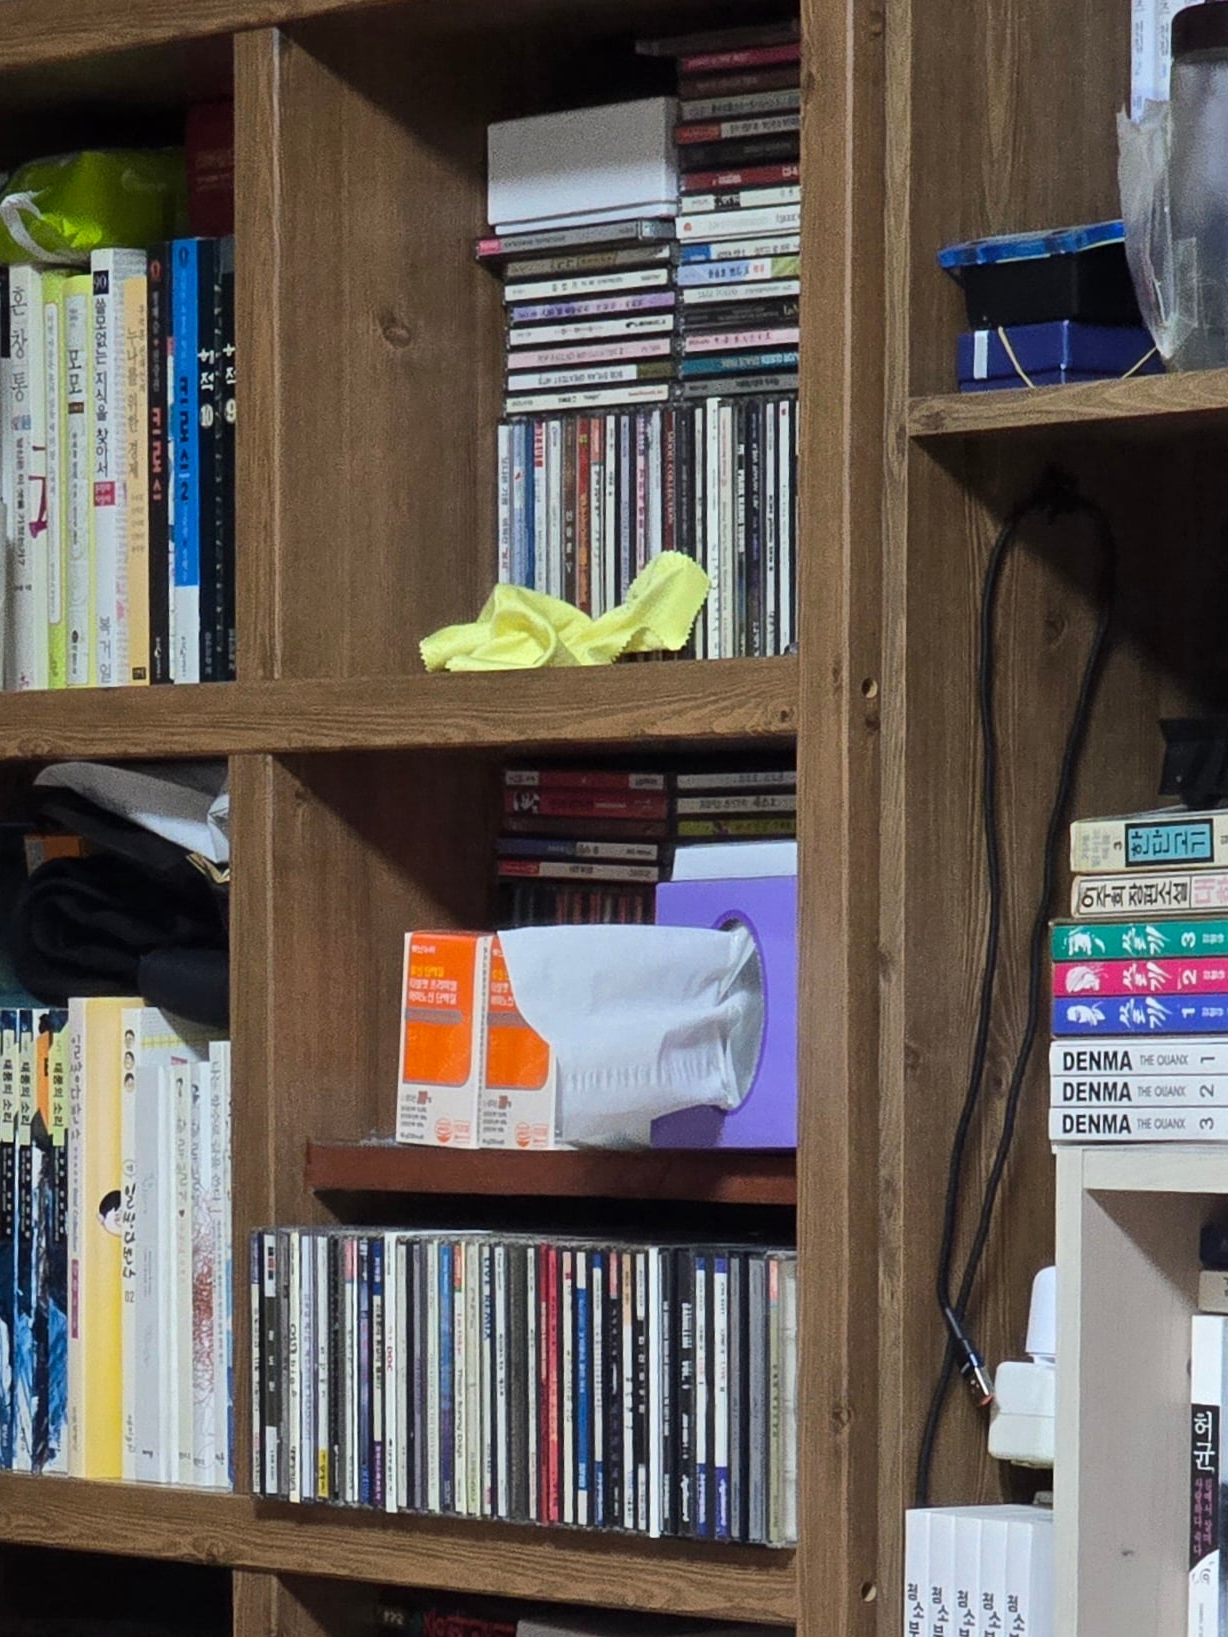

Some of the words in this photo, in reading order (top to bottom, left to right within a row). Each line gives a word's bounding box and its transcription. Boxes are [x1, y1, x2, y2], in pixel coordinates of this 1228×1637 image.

[10, 288, 29, 402] 혼창통
[95, 298, 108, 365] 쓸모없는
[69, 349, 82, 395] 모모
[95, 373, 108, 421] 지식을
[180, 376, 190, 471] 크로스
[95, 428, 109, 478] 찾아서
[150, 407, 163, 501] 크로스
[181, 481, 189, 500] 2
[99, 616, 113, 684] 복거일
[1131, 827, 1207, 857] 한단고기
[1128, 881, 1188, 907] 장편소설
[1122, 924, 1171, 956] 쓸개
[1181, 931, 1196, 948] 3
[1122, 961, 1172, 991] 쓸개
[1182, 969, 1197, 985] 2
[1119, 997, 1172, 1029] 쓸개
[1181, 1007, 1196, 1018] 1
[1063, 1051, 1133, 1071] DENMA
[1140, 1055, 1155, 1066] THE
[1157, 1055, 1188, 1066] QUANX
[1201, 1056, 1215, 1064] 1
[1063, 1082, 1132, 1102] DENMA
[1137, 1086, 1152, 1097] THE
[1155, 1085, 1186, 1097] QUANX
[1200, 1084, 1214, 1098] 2
[3, 1098, 13, 1123] 소리
[20, 1102, 31, 1127] 소리
[53, 1103, 64, 1128] 소리
[1062, 1114, 1132, 1134] DENMA
[1137, 1118, 1152, 1130] THE
[1154, 1118, 1186, 1130] QUANX
[1200, 1117, 1214, 1130] 3
